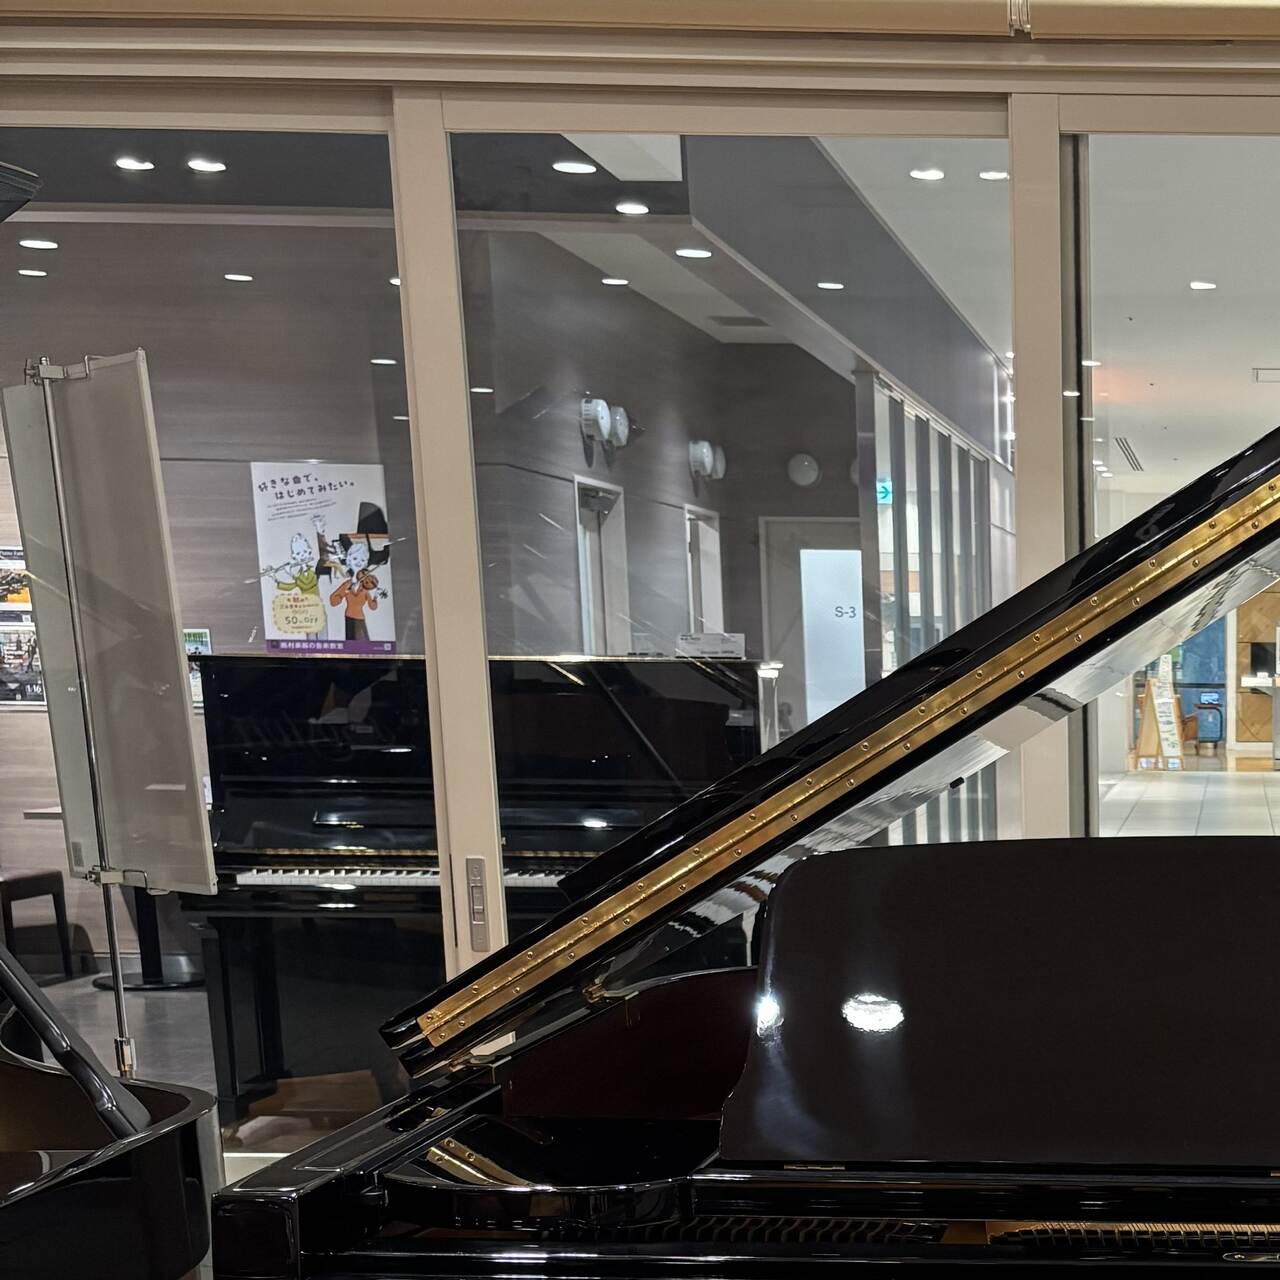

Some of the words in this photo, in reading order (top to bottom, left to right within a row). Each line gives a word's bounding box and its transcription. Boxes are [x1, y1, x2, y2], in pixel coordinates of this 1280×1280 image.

[275, 481, 354, 499] はじめてみたい。
[834, 606, 857, 619] S-3
